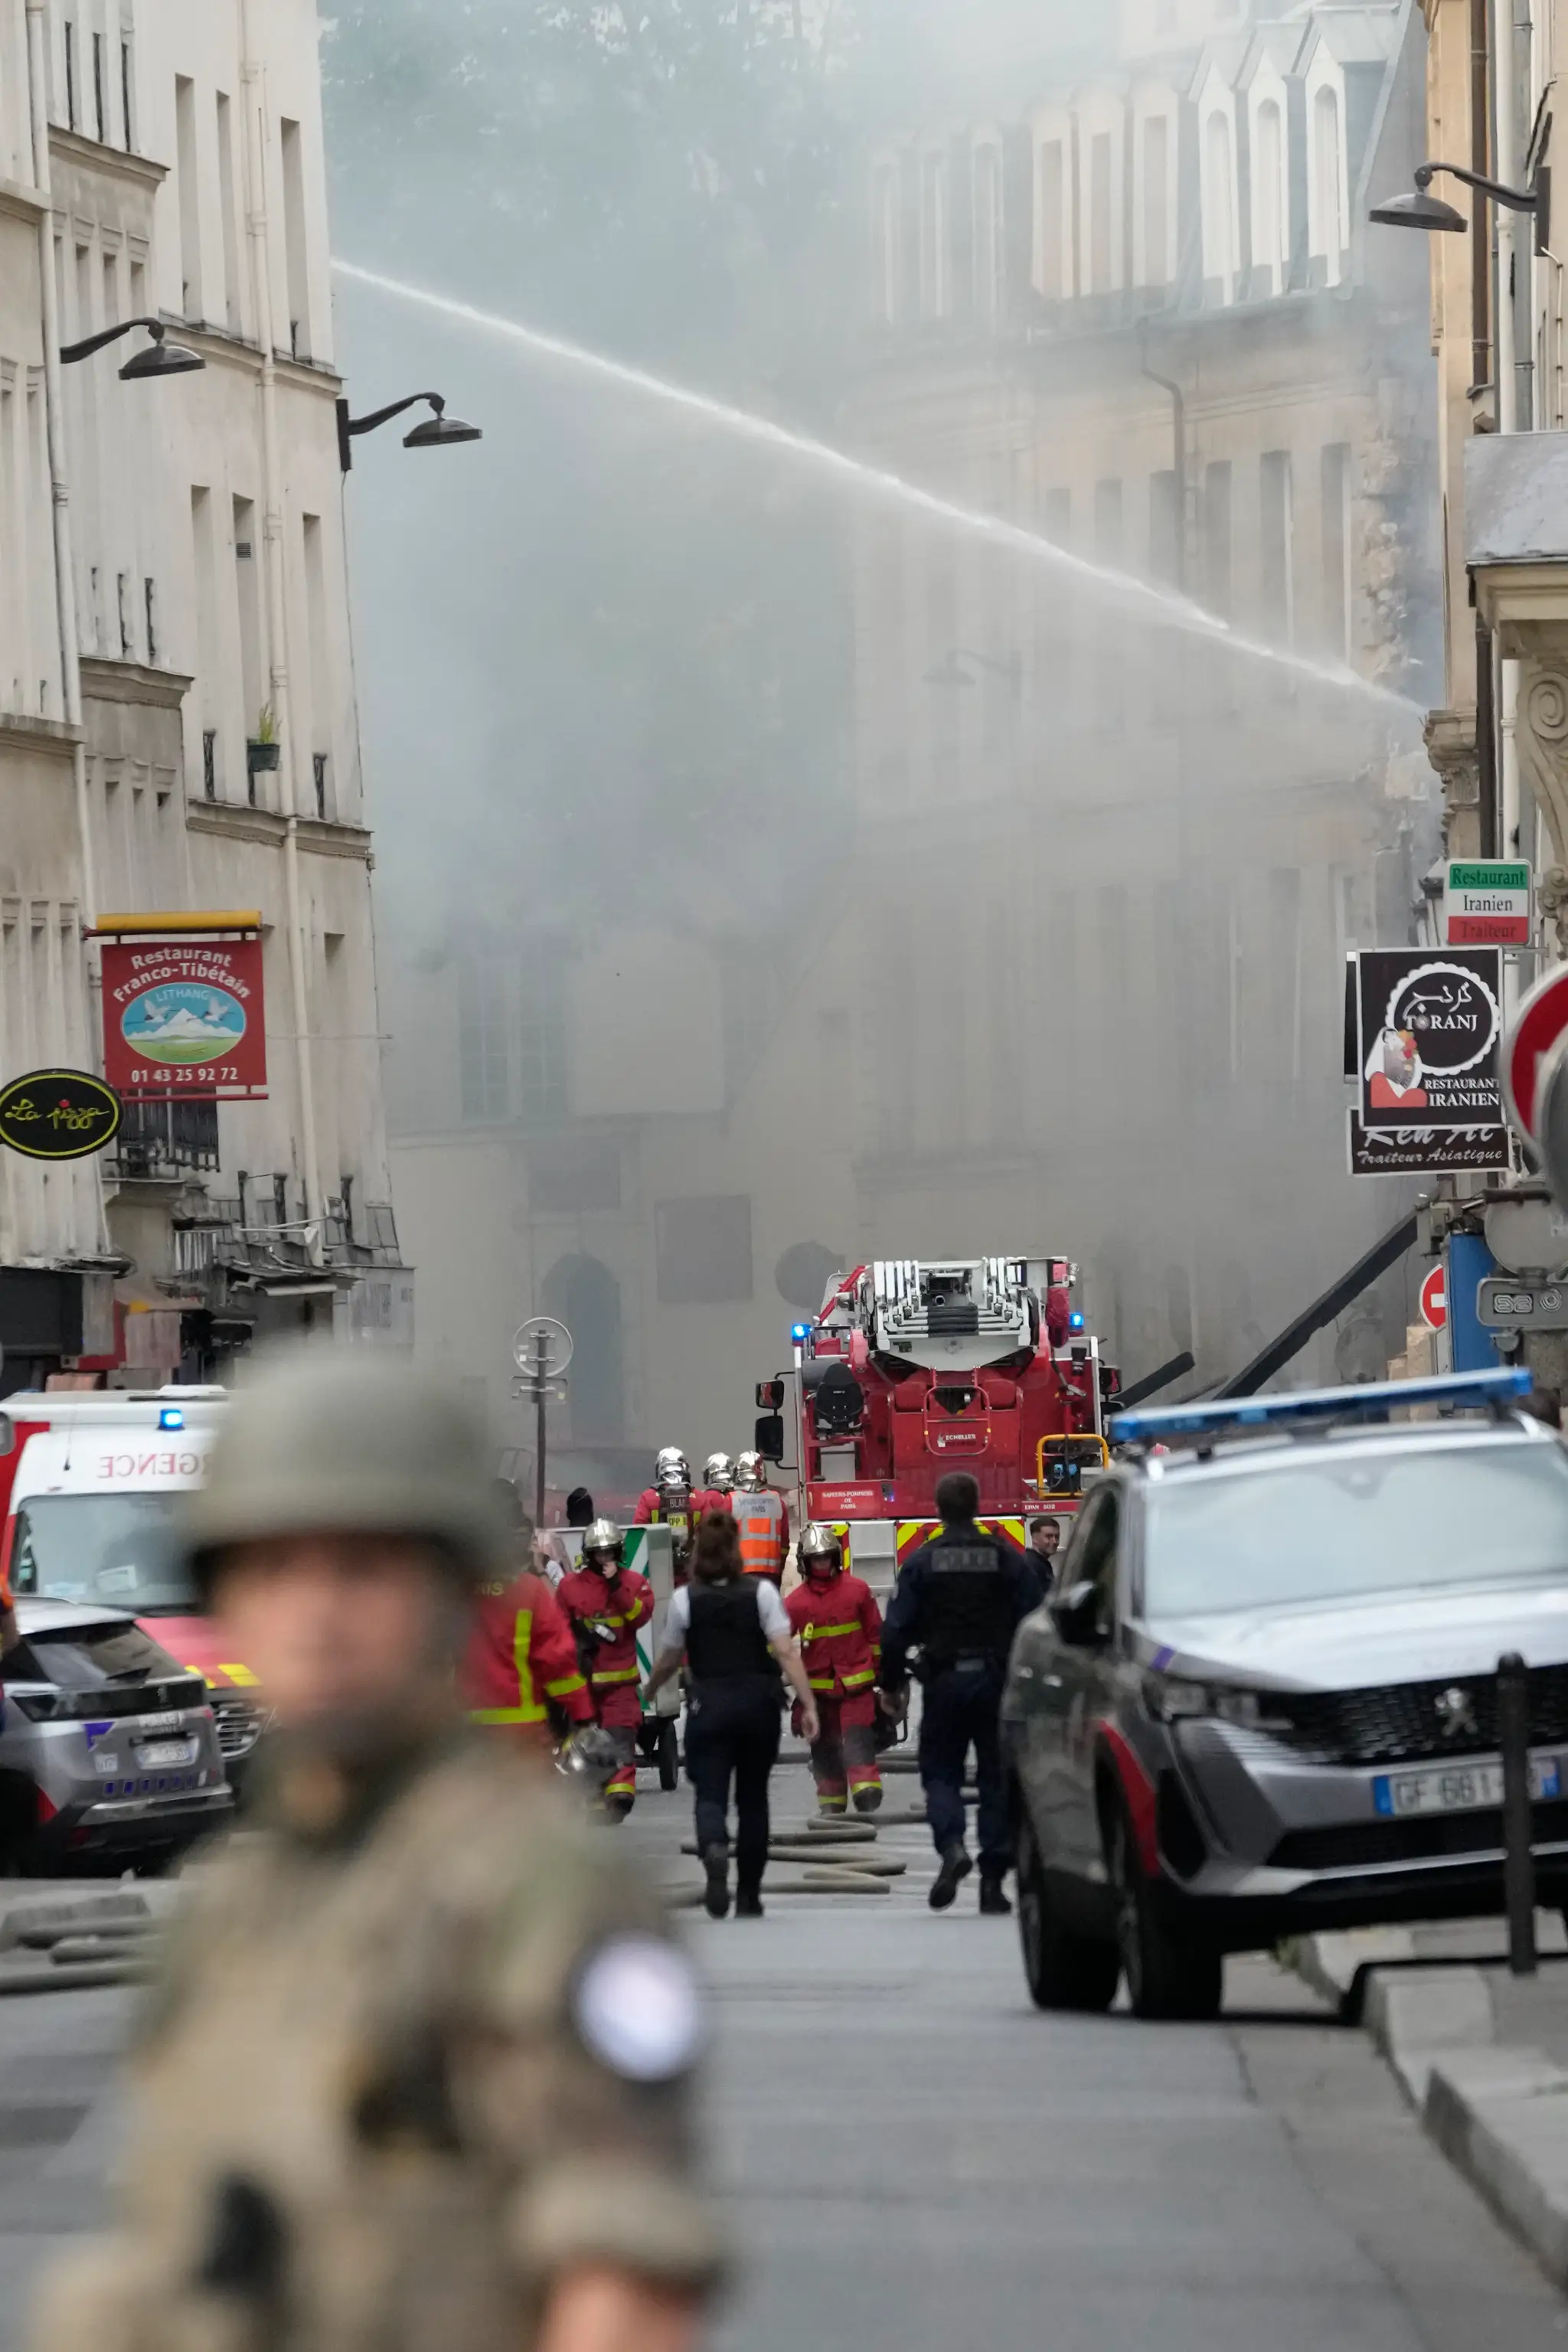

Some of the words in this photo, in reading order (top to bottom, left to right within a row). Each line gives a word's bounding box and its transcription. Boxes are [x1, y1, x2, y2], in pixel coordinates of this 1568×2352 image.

[1452, 867, 1525, 885] Restaurant
[1464, 894, 1513, 912] Iranien
[1461, 921, 1517, 938] Traiteur
[131, 947, 233, 970] Restaurant
[113, 962, 251, 1002] Franco-Tibétain
[132, 1070, 149, 1083] 01
[153, 1069, 172, 1082] 43
[175, 1068, 194, 1082] 25
[198, 1068, 216, 1081] 92
[220, 1067, 239, 1080] 72
[1429, 1093, 1500, 1107] IRANIEN
[5, 1099, 44, 1121] La
[46, 1099, 110, 1130] pizza
[1357, 1150, 1423, 1165] Traiteur
[1426, 1148, 1503, 1164] Asiatique
